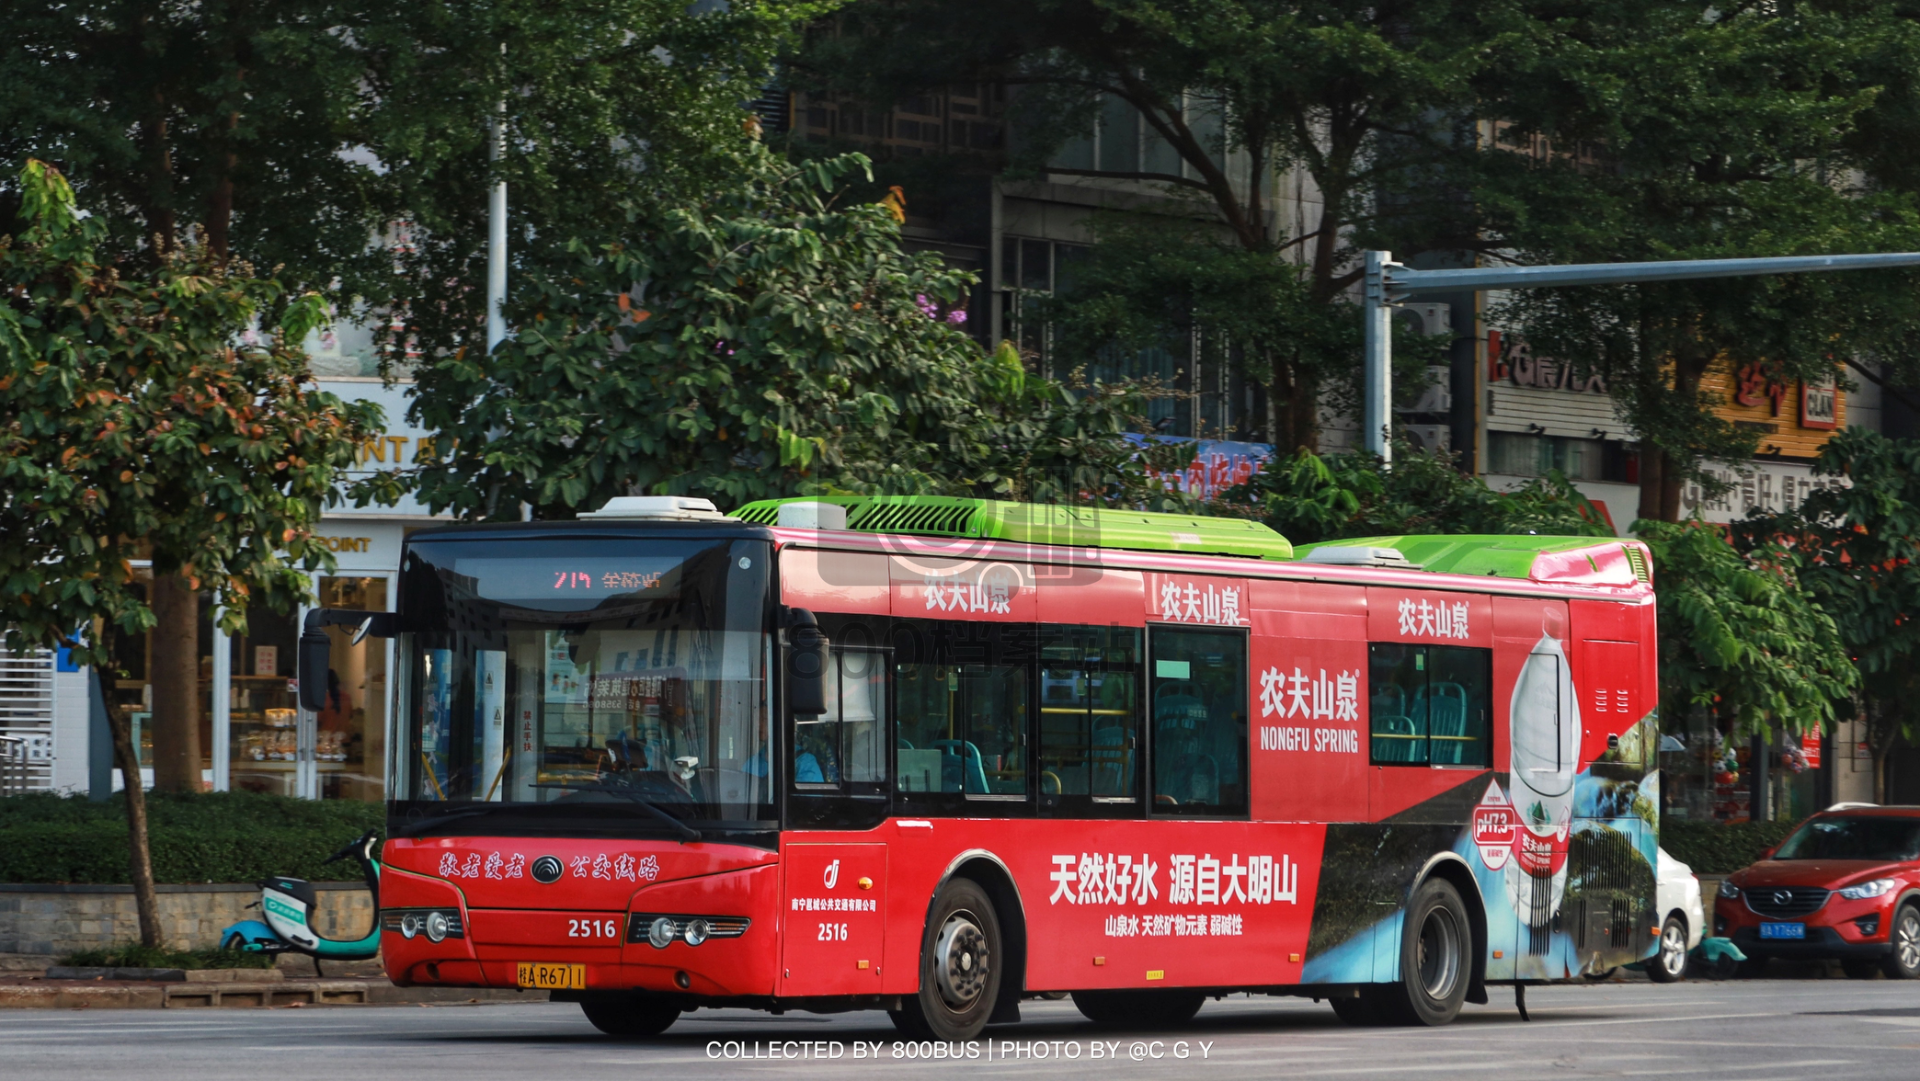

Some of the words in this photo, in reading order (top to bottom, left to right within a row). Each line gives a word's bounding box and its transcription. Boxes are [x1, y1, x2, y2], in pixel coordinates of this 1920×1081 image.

[924, 571, 1012, 615] 农夫山泉
[1161, 581, 1241, 626] 农夫山泉
[1398, 598, 1470, 640] 农夫山泉
[1259, 666, 1359, 722] 农夫山泉
[1260, 726, 1310, 752] NONGFU
[1314, 728, 1358, 754] SPRING
[1476, 812, 1508, 838] pH7.3
[438, 851, 525, 880] 敬老爱老
[569, 853, 660, 882] 公交线路
[1050, 852, 1159, 906] 天然好水
[1169, 853, 1298, 906] 源自大明山
[791, 897, 877, 912] 南宁邕城公共交通有限公司
[568, 919, 616, 938] 2516
[817, 922, 849, 942] 2516
[1105, 914, 1140, 938] 山泉水
[1142, 914, 1208, 937] 天然矿物元素
[1210, 914, 1243, 937] 弱碱性
